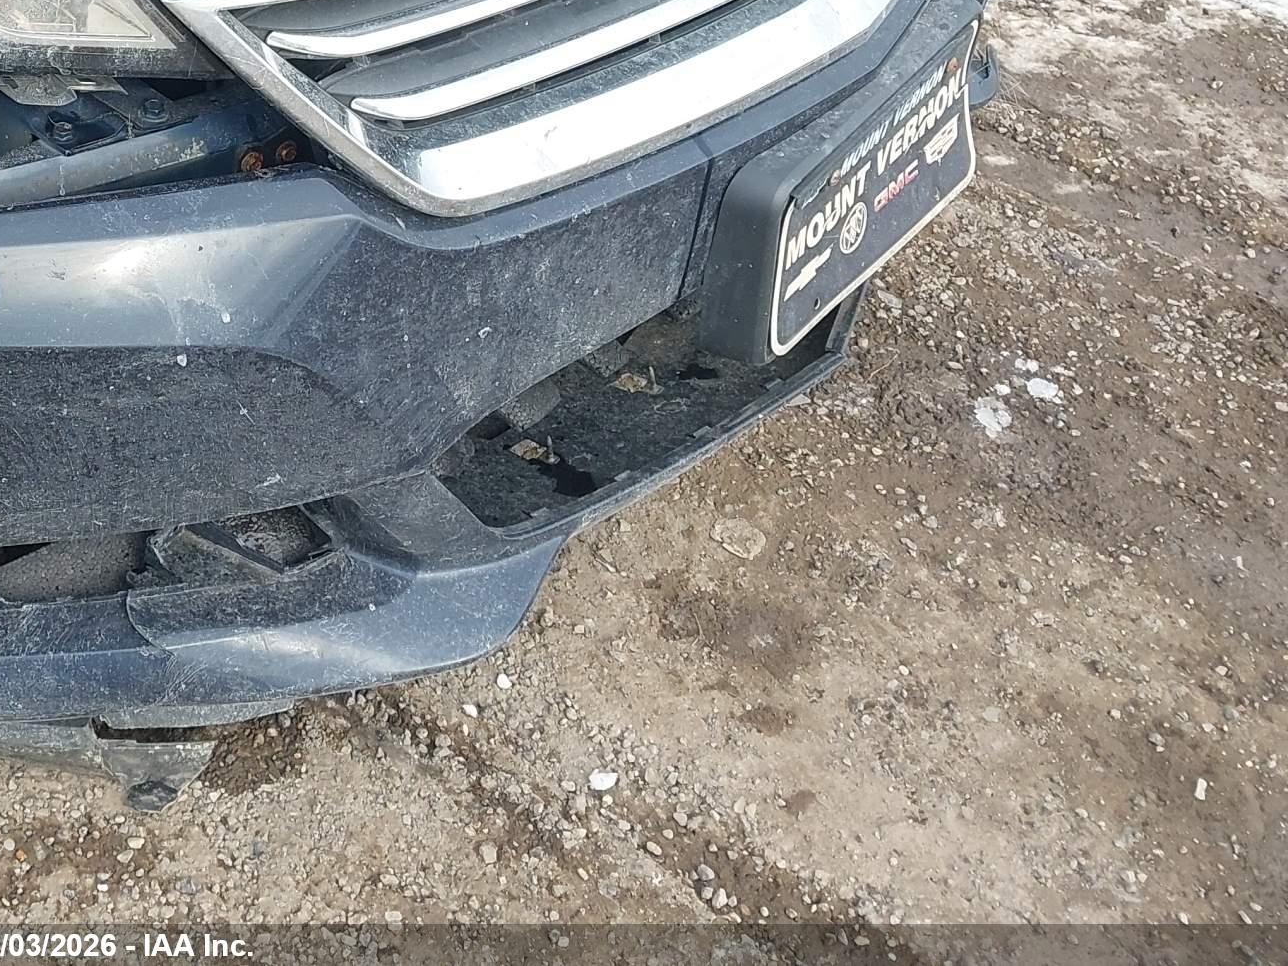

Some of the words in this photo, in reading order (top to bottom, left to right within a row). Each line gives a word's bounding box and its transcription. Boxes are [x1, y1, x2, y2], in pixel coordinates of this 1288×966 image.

[785, 160, 872, 271] MOUNT
[877, 67, 965, 176] VERNON
[840, 119, 890, 178] MOUNT
[892, 60, 948, 127] VERNON
[874, 159, 919, 212] GMC
